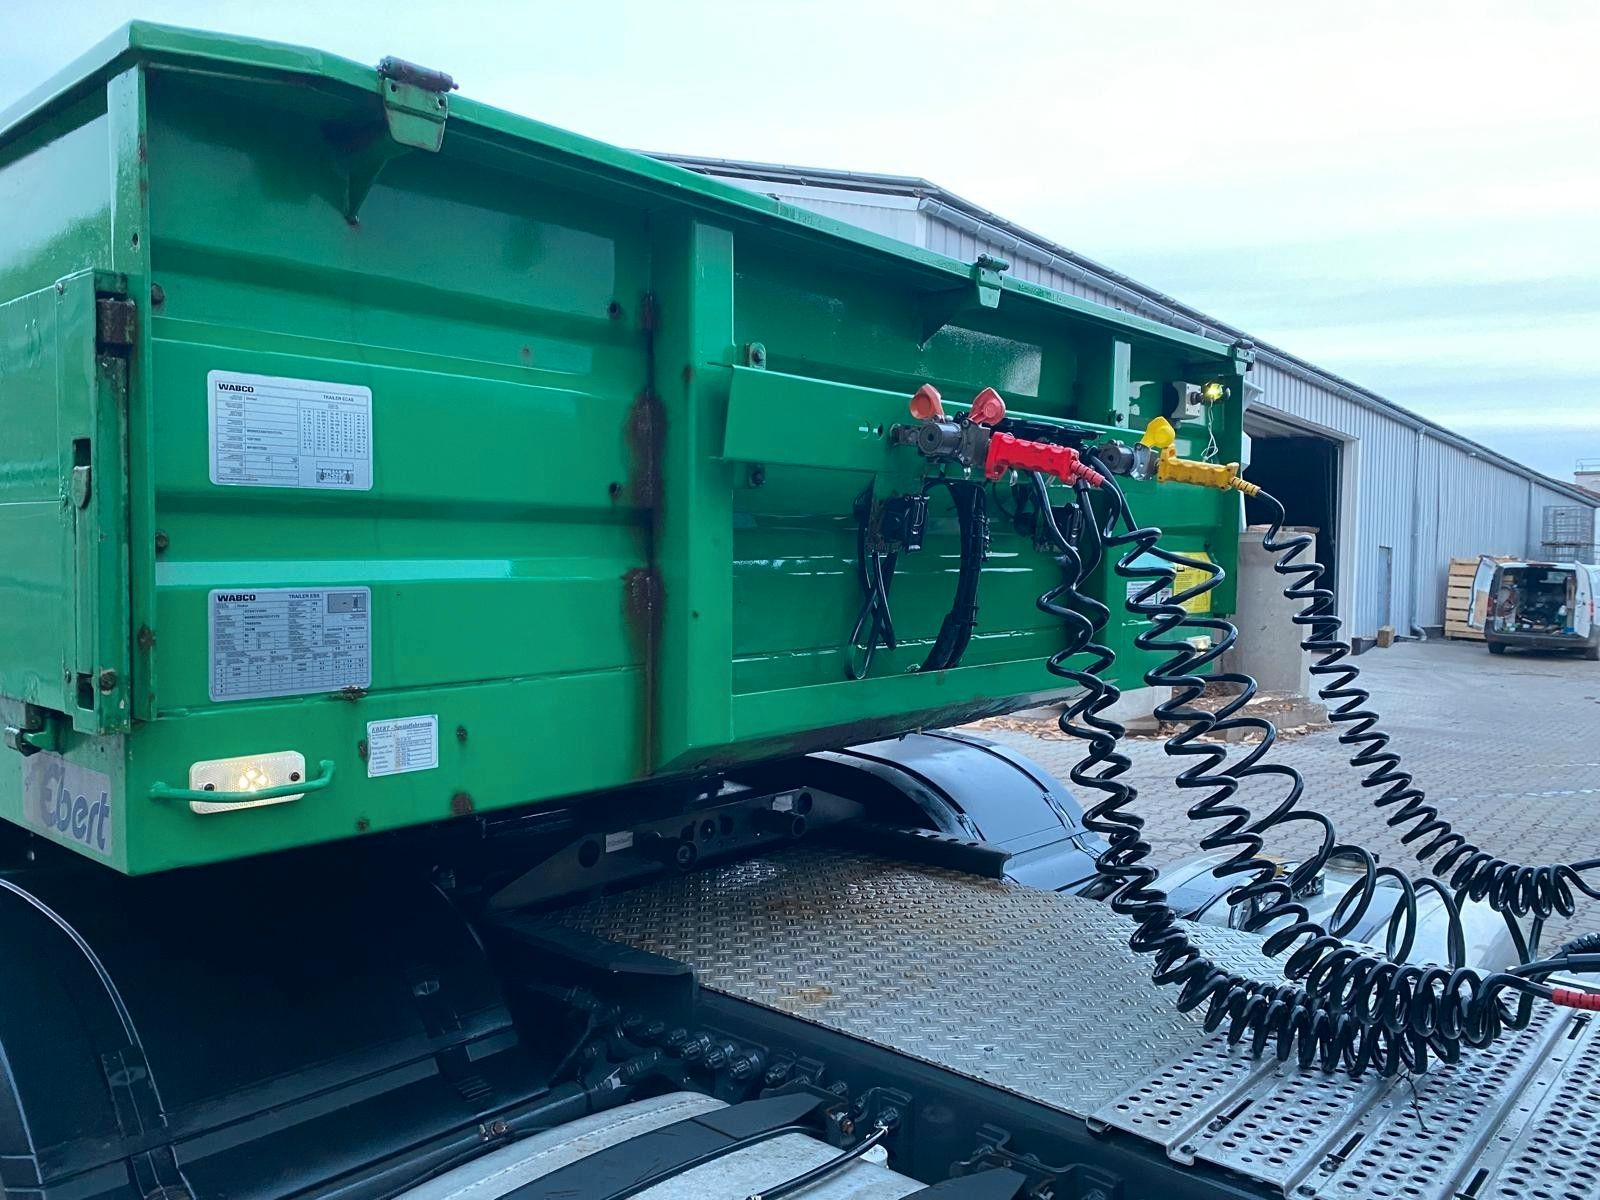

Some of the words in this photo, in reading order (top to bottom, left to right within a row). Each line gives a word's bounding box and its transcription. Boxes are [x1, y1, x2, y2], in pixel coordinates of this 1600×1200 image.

[218, 383, 254, 393] WABCO
[217, 594, 256, 602] WABCO
[41, 763, 110, 851] Ebert
